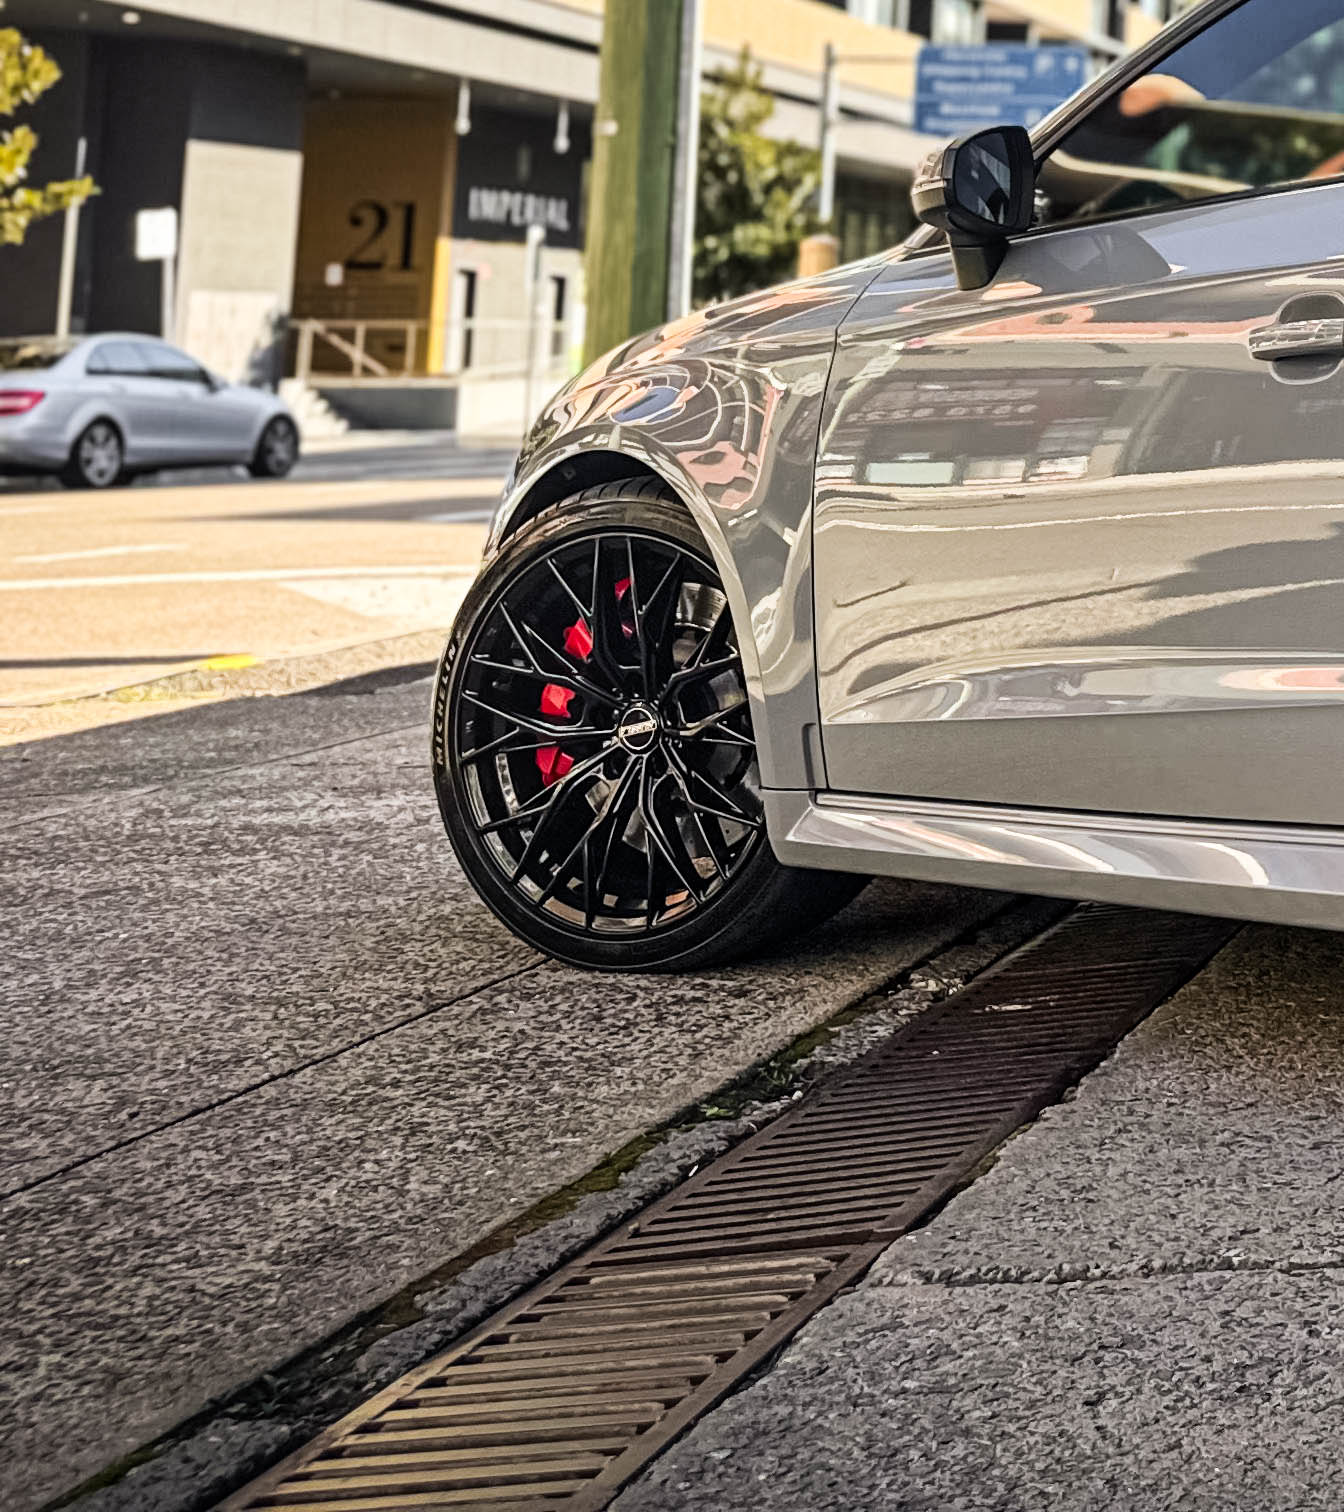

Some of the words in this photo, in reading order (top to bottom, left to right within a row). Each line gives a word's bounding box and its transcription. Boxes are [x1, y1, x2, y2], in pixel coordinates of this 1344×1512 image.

[344, 199, 418, 273] 21
[468, 186, 570, 232] IMPERIAL
[434, 642, 457, 766] MICHELIN
